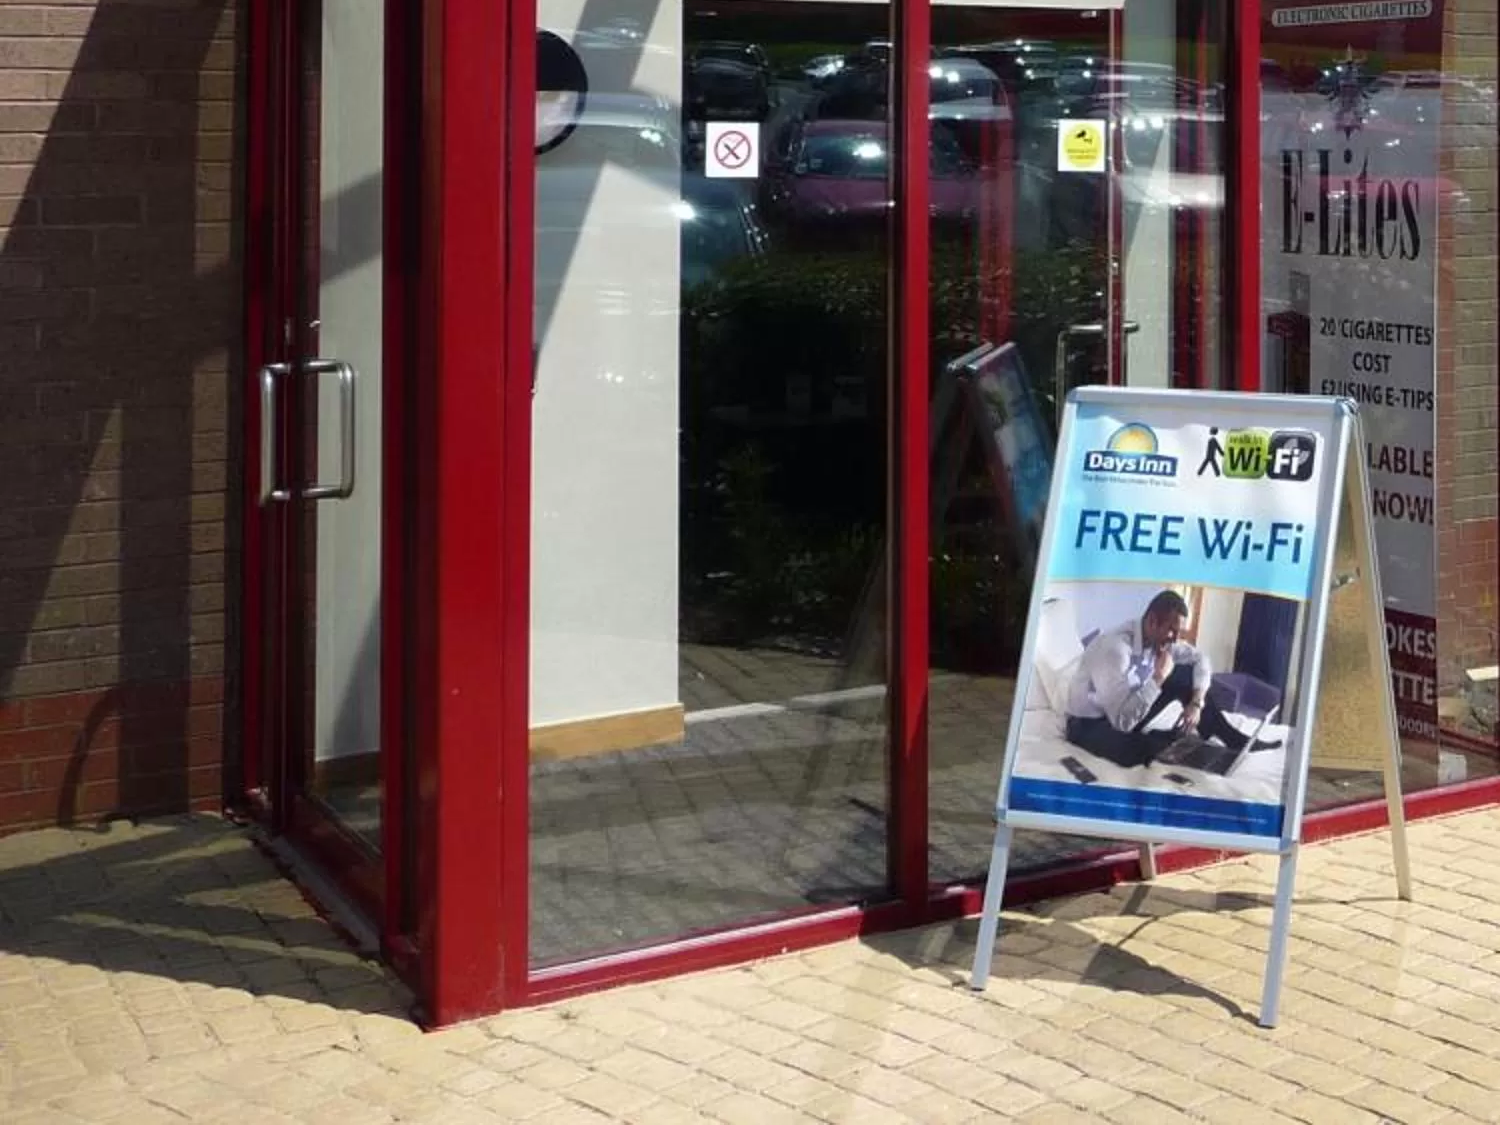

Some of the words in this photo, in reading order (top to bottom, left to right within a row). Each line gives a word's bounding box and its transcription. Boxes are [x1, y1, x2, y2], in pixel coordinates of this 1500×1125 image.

[1276, 6, 1348, 25] ELECTRONIC
[1350, 0, 1428, 20] CIGARETTES
[1281, 148, 1421, 261] E-Lites
[1320, 317, 1337, 336] 20
[1352, 351, 1392, 374] COST
[1338, 381, 1383, 405] USING
[1385, 386, 1434, 412] E-TIPS
[1089, 452, 1138, 473] Days
[1140, 456, 1172, 474] Inn
[1367, 442, 1434, 479] LABLE
[1373, 487, 1434, 527] NOW!
[1075, 509, 1185, 556] FREE
[1197, 517, 1304, 564] Wi-Fi
[1384, 621, 1436, 660] OKES
